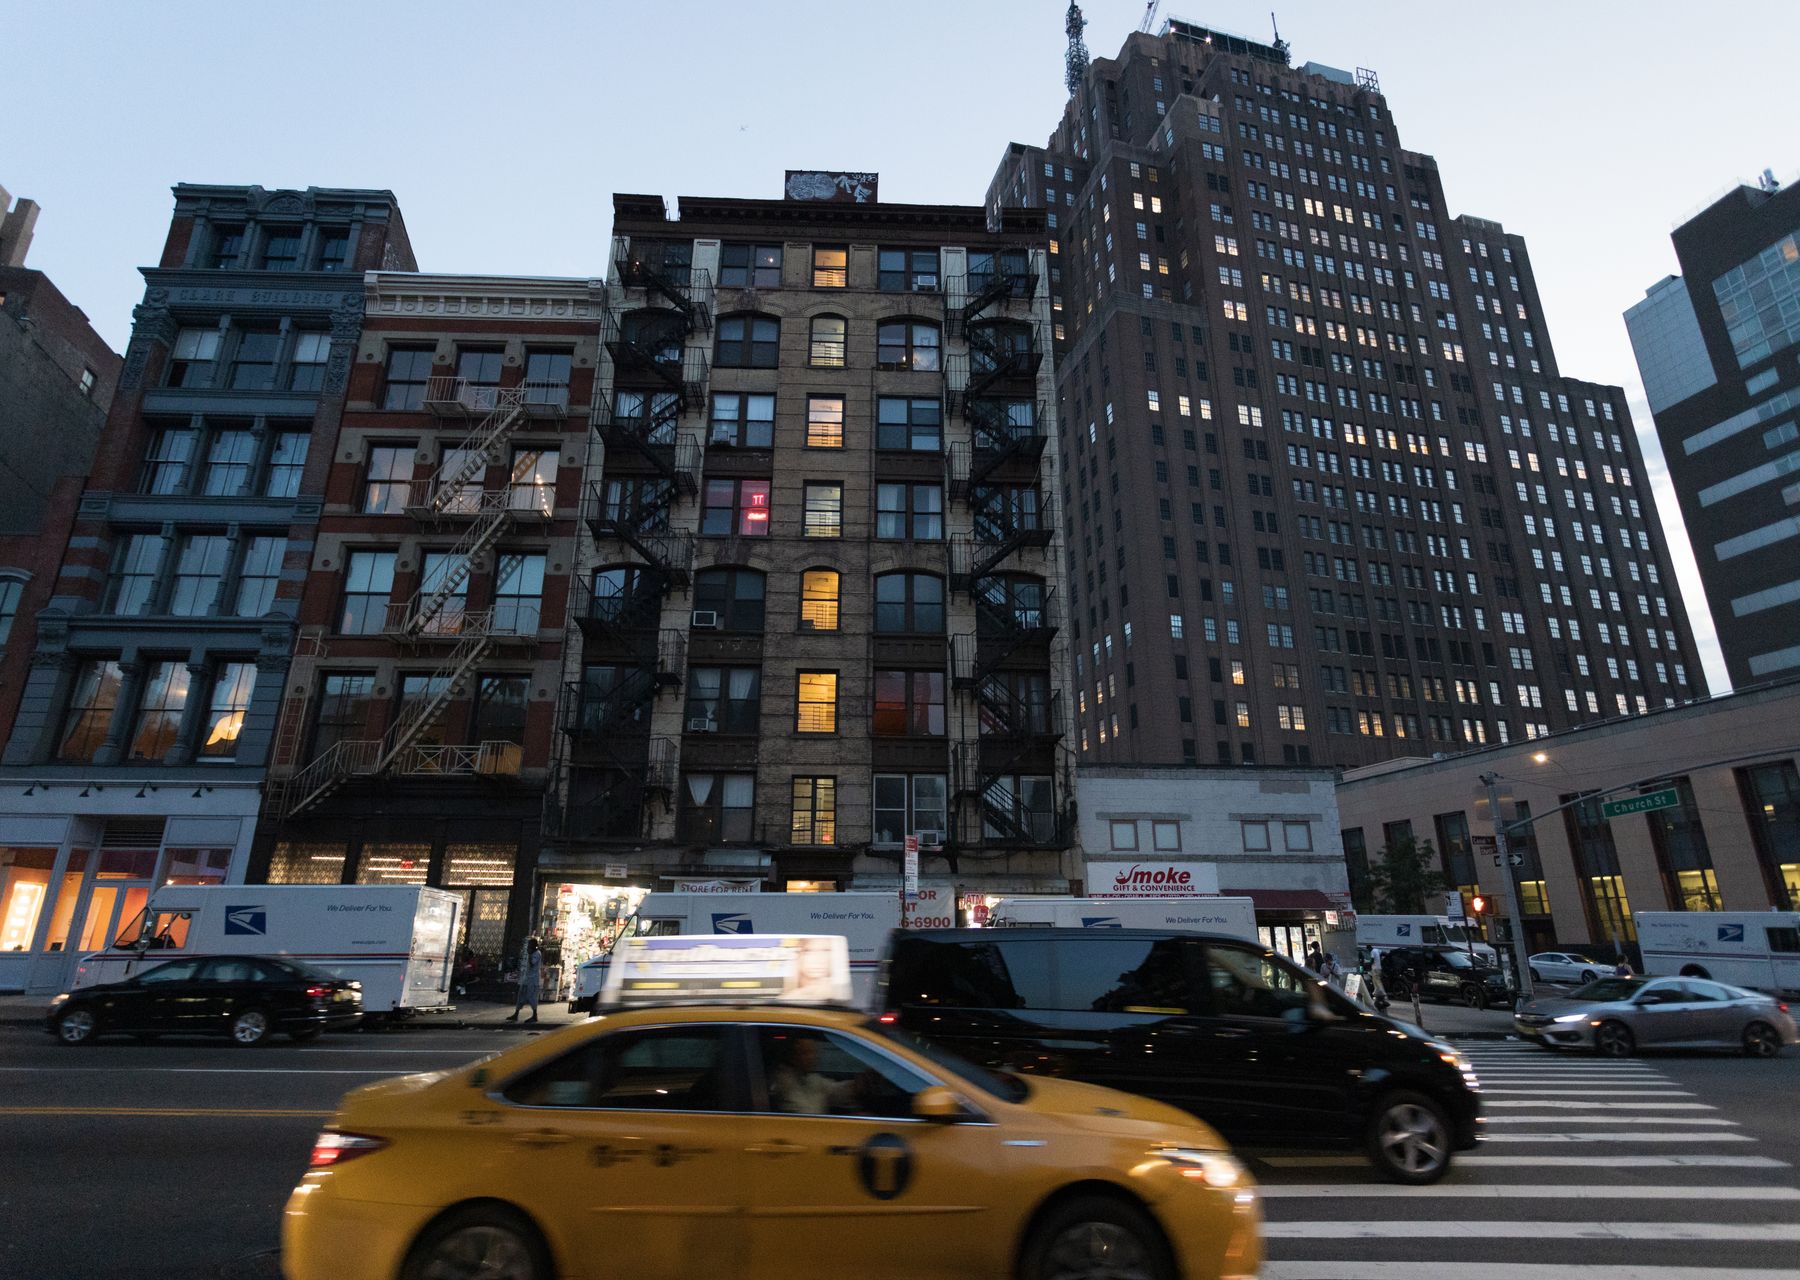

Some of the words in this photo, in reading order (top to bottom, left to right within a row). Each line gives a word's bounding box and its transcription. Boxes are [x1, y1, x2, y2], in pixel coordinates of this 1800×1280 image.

[1614, 798, 1653, 813] Church
[1654, 796, 1667, 805] St
[680, 883, 709, 893] STORE
[711, 885, 729, 893] FOR
[732, 885, 754, 893] RENT
[1113, 884, 1130, 892] GIFT
[1140, 884, 1195, 892] CONVENIENCE
[966, 894, 984, 905] ATM
[902, 902, 917, 912] NT
[822, 912, 847, 920] Deliver
[898, 916, 951, 928] 6-6900
